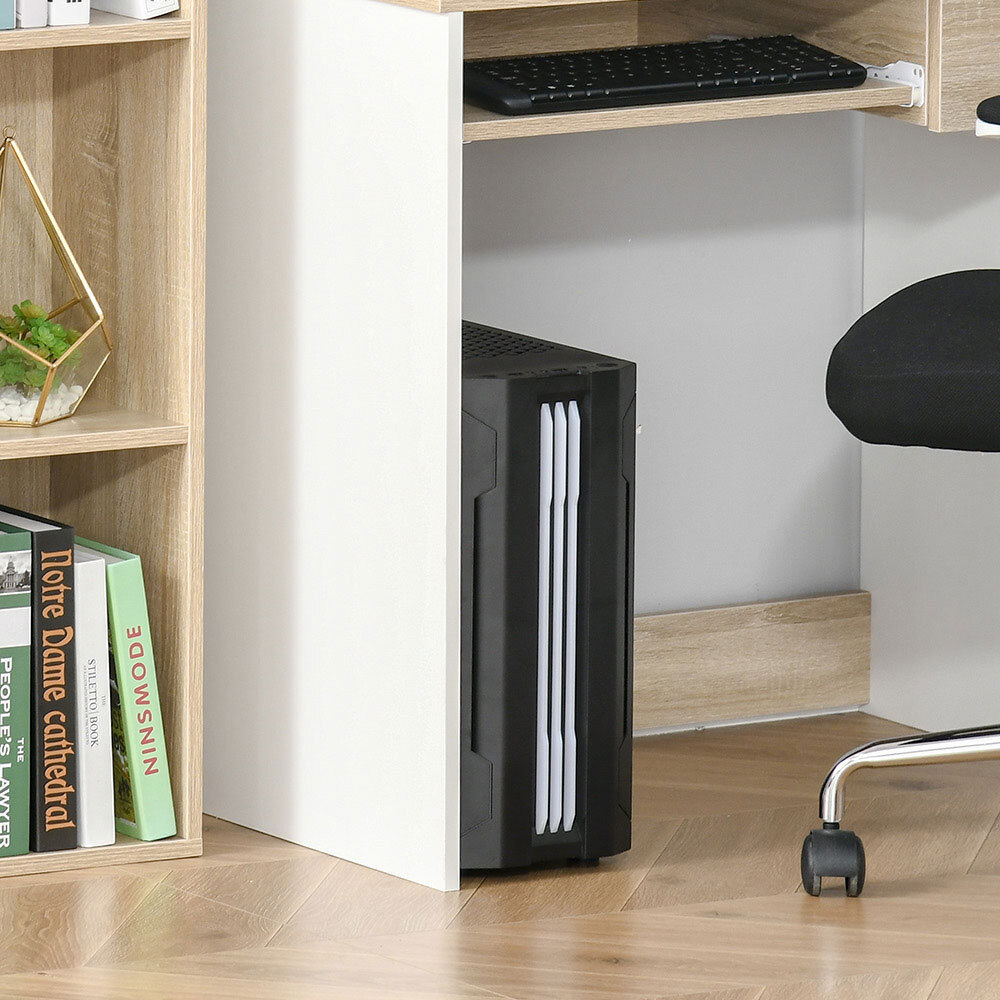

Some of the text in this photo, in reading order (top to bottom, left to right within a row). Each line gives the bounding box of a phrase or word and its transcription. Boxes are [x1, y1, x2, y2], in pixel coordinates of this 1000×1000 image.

[0, 656, 13, 849] PEOPLE'S LAWYER
[16, 737, 24, 763] THE
[40, 549, 76, 832] Notre Dame cathedral
[88, 659, 99, 748] STILETTO BOOK
[126, 624, 159, 776] NINSMODE
